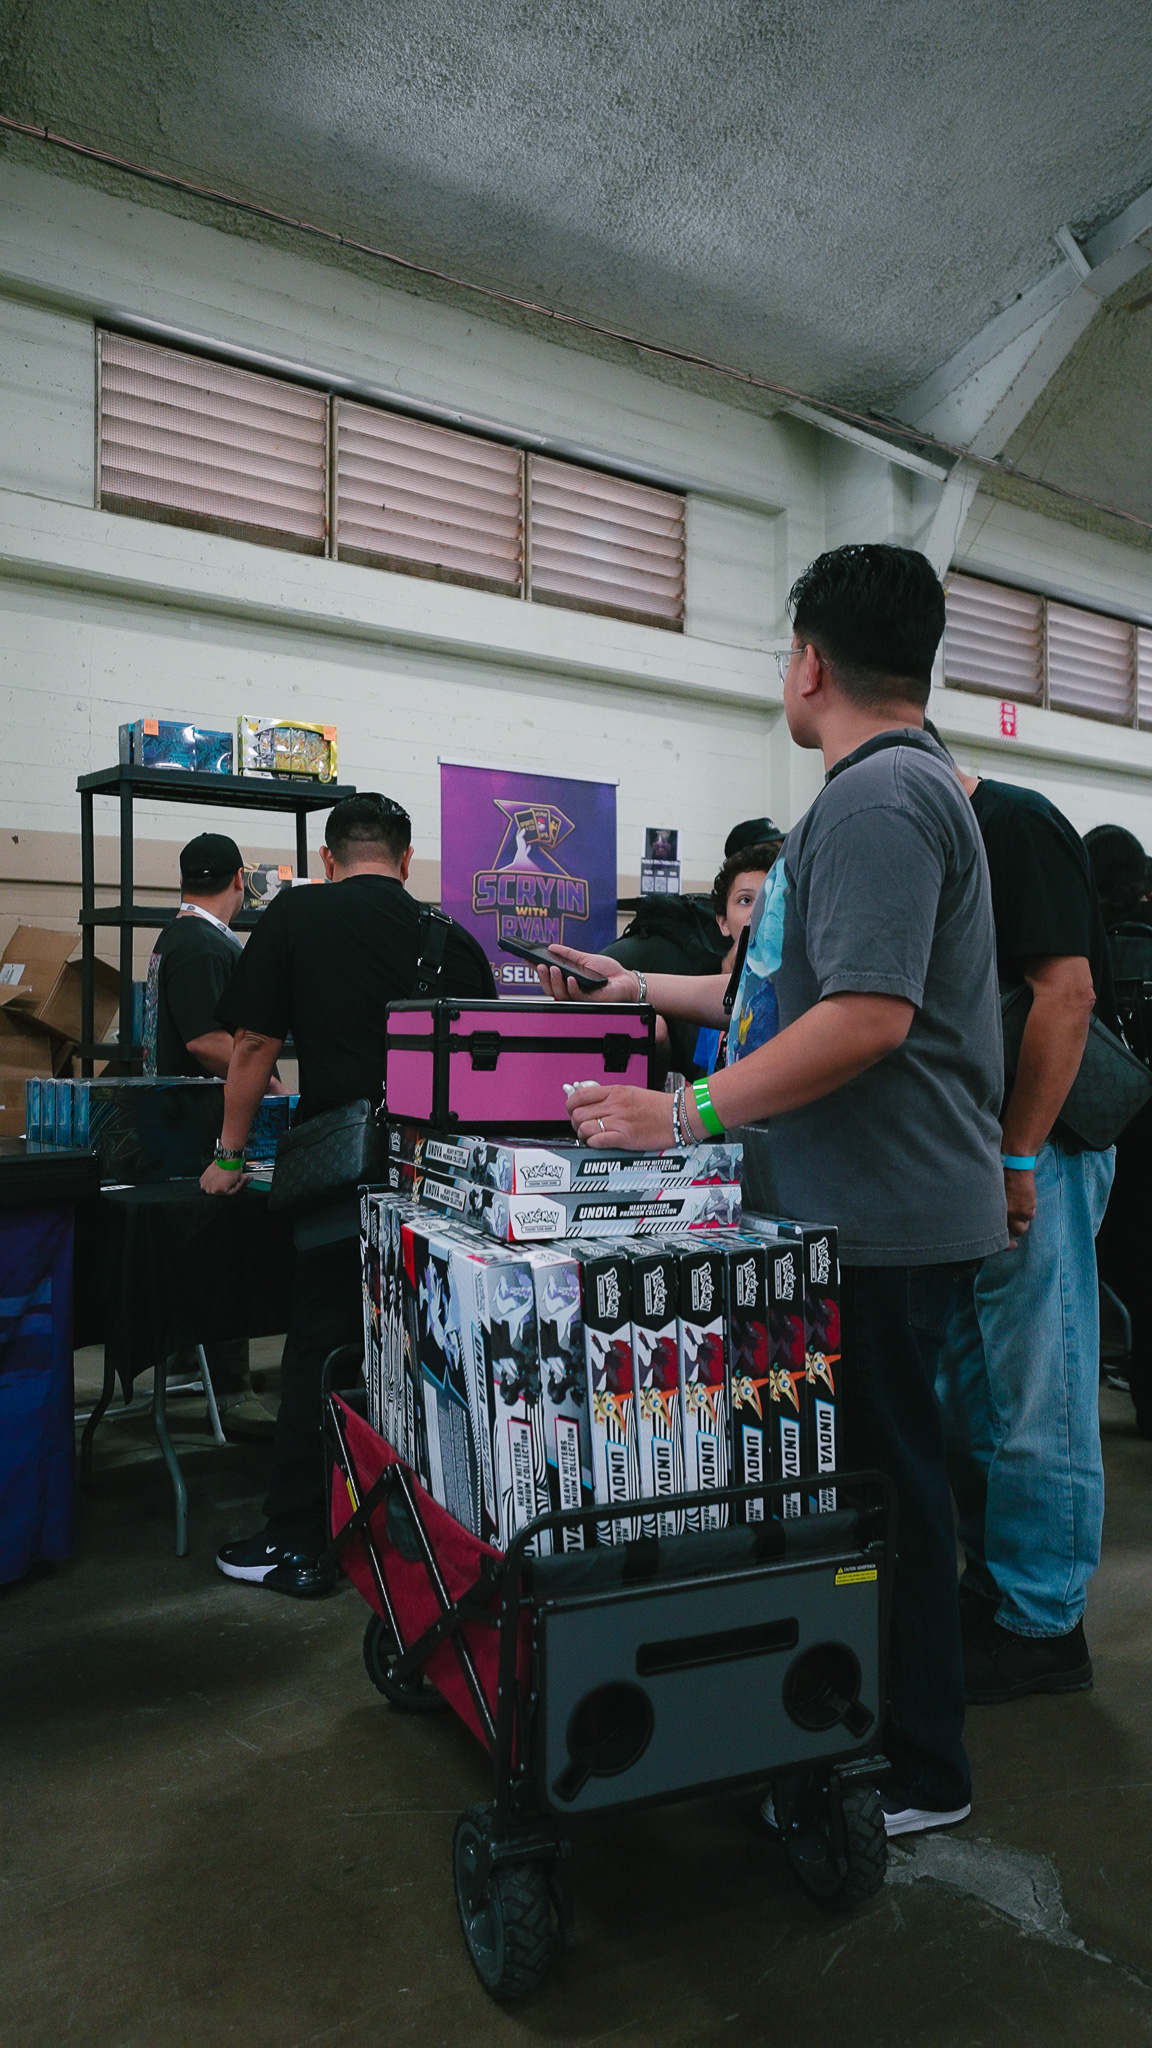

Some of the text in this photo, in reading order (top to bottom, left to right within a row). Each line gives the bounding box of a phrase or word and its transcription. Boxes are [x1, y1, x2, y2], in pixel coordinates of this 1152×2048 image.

[477, 875, 585, 914] SCRYIN
[516, 906, 548, 917] WITH
[502, 915, 560, 944] RYAN
[583, 1161, 622, 1174] UNOVA
[579, 1206, 617, 1219] UNOVA
[646, 1208, 678, 1216] COLLECTION
[474, 1337, 487, 1405] UNOVA
[819, 1410, 832, 1464] UNOVA
[513, 1442, 525, 1507] HEAVY HITTERS
[520, 1429, 533, 1520] PREMIUM COLLECTION
[560, 1440, 571, 1505] HEAVY HITTERS
[567, 1427, 579, 1508] EMIUM COLLECTION
